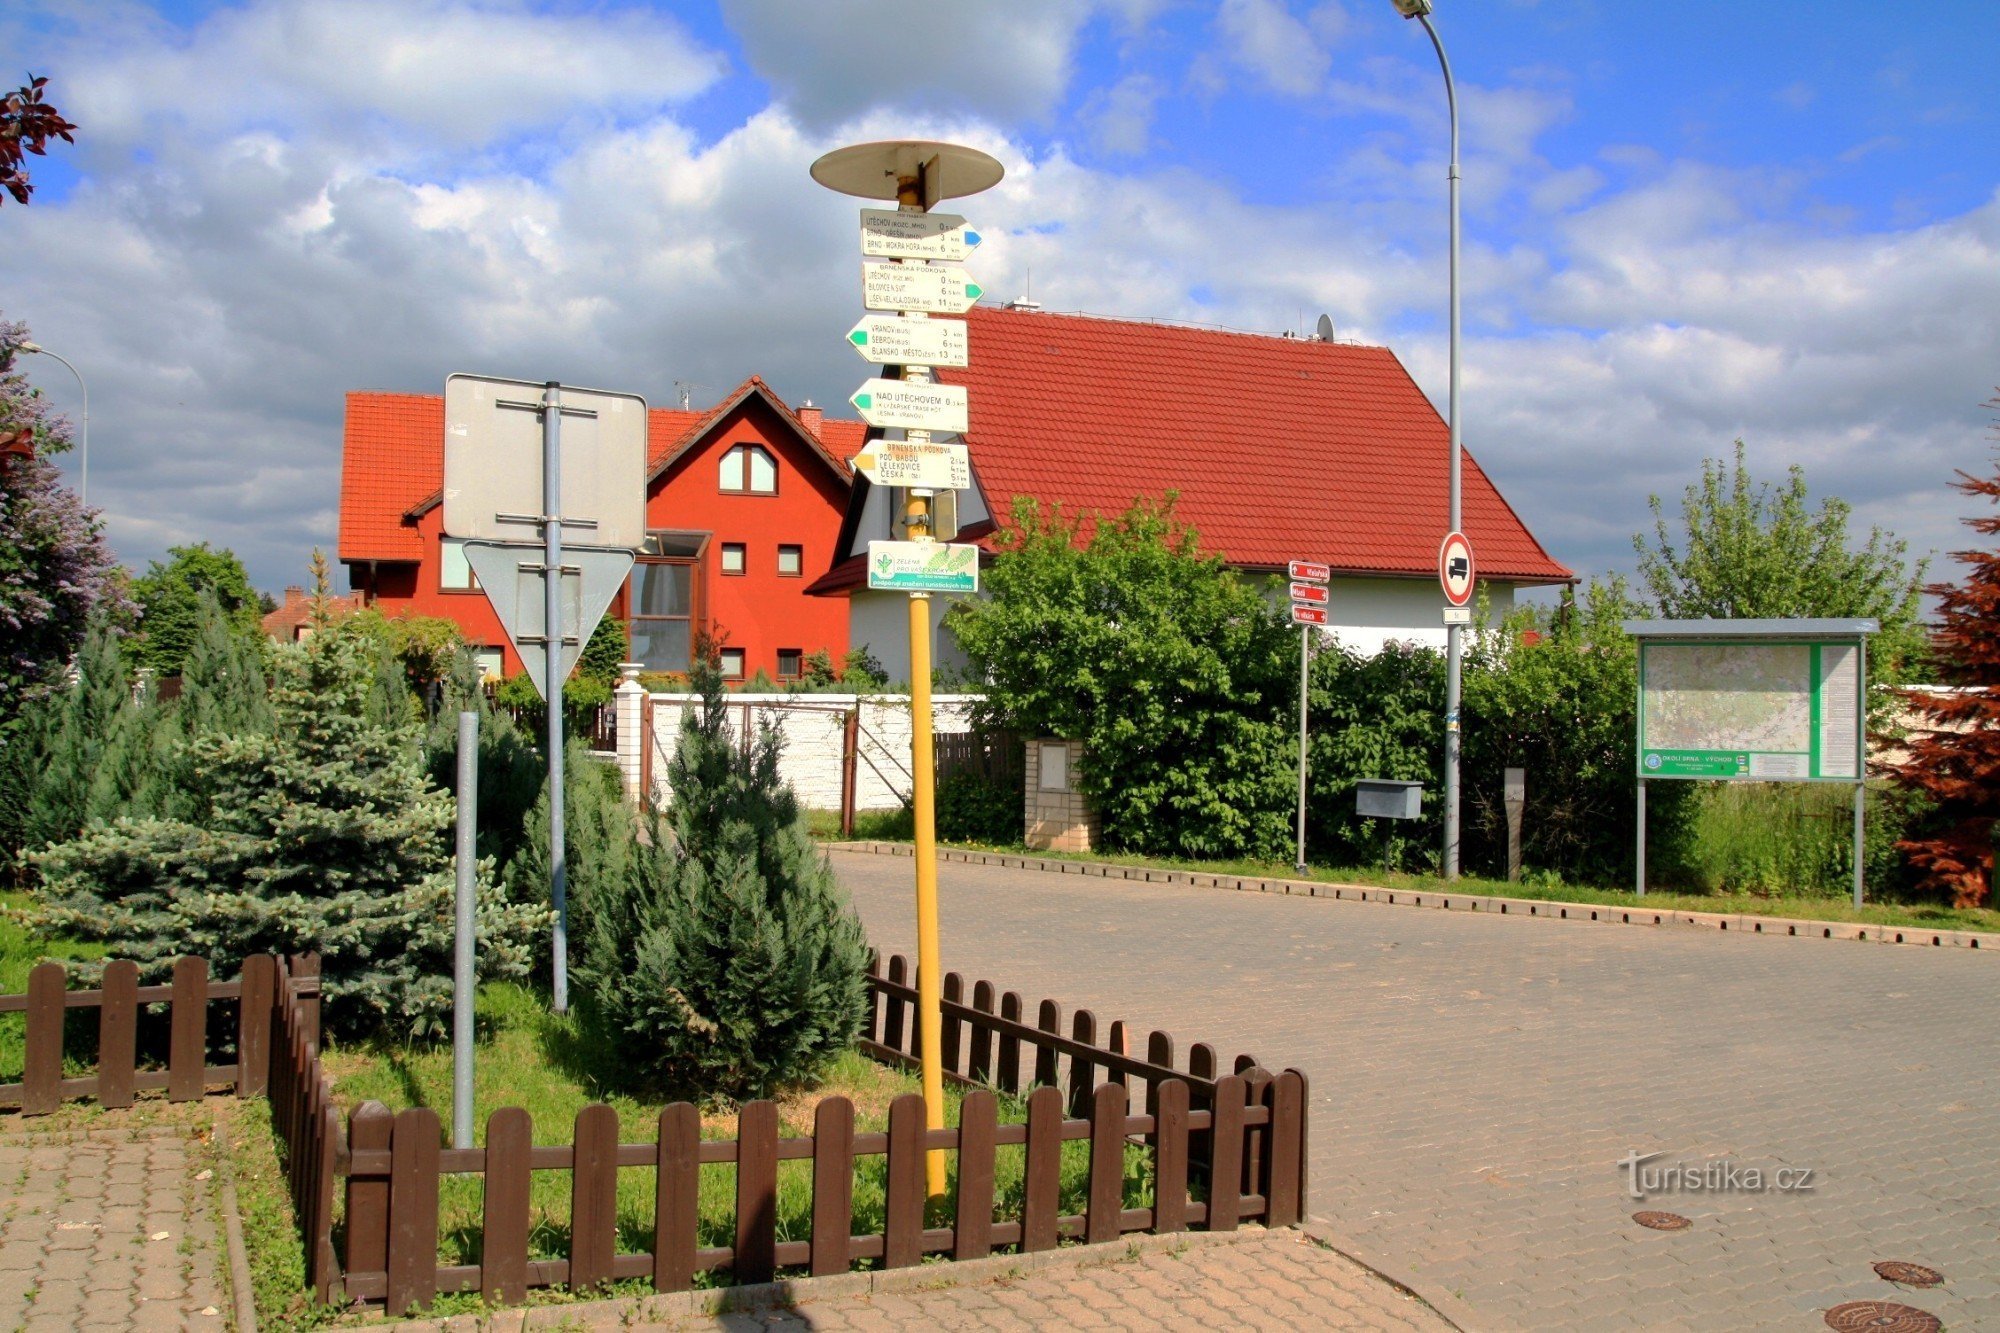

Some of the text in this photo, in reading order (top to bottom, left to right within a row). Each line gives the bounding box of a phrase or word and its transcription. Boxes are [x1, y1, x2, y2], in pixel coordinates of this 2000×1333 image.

[866, 228, 882, 237] BRNO
[940, 233, 945, 242] 3
[868, 240, 882, 249] BRNO
[940, 244, 946, 253] 6
[942, 328, 948, 336] 3
[871, 346, 898, 356] BLANSKO
[902, 348, 922, 357] MĚSTO
[940, 350, 948, 359] 13
[876, 392, 892, 401] NAD
[924, 445, 952, 454] PODKOVA
[880, 453, 892, 461] POD
[895, 454, 918, 462] BABOU
[880, 462, 921, 471] LELEKOVICE
